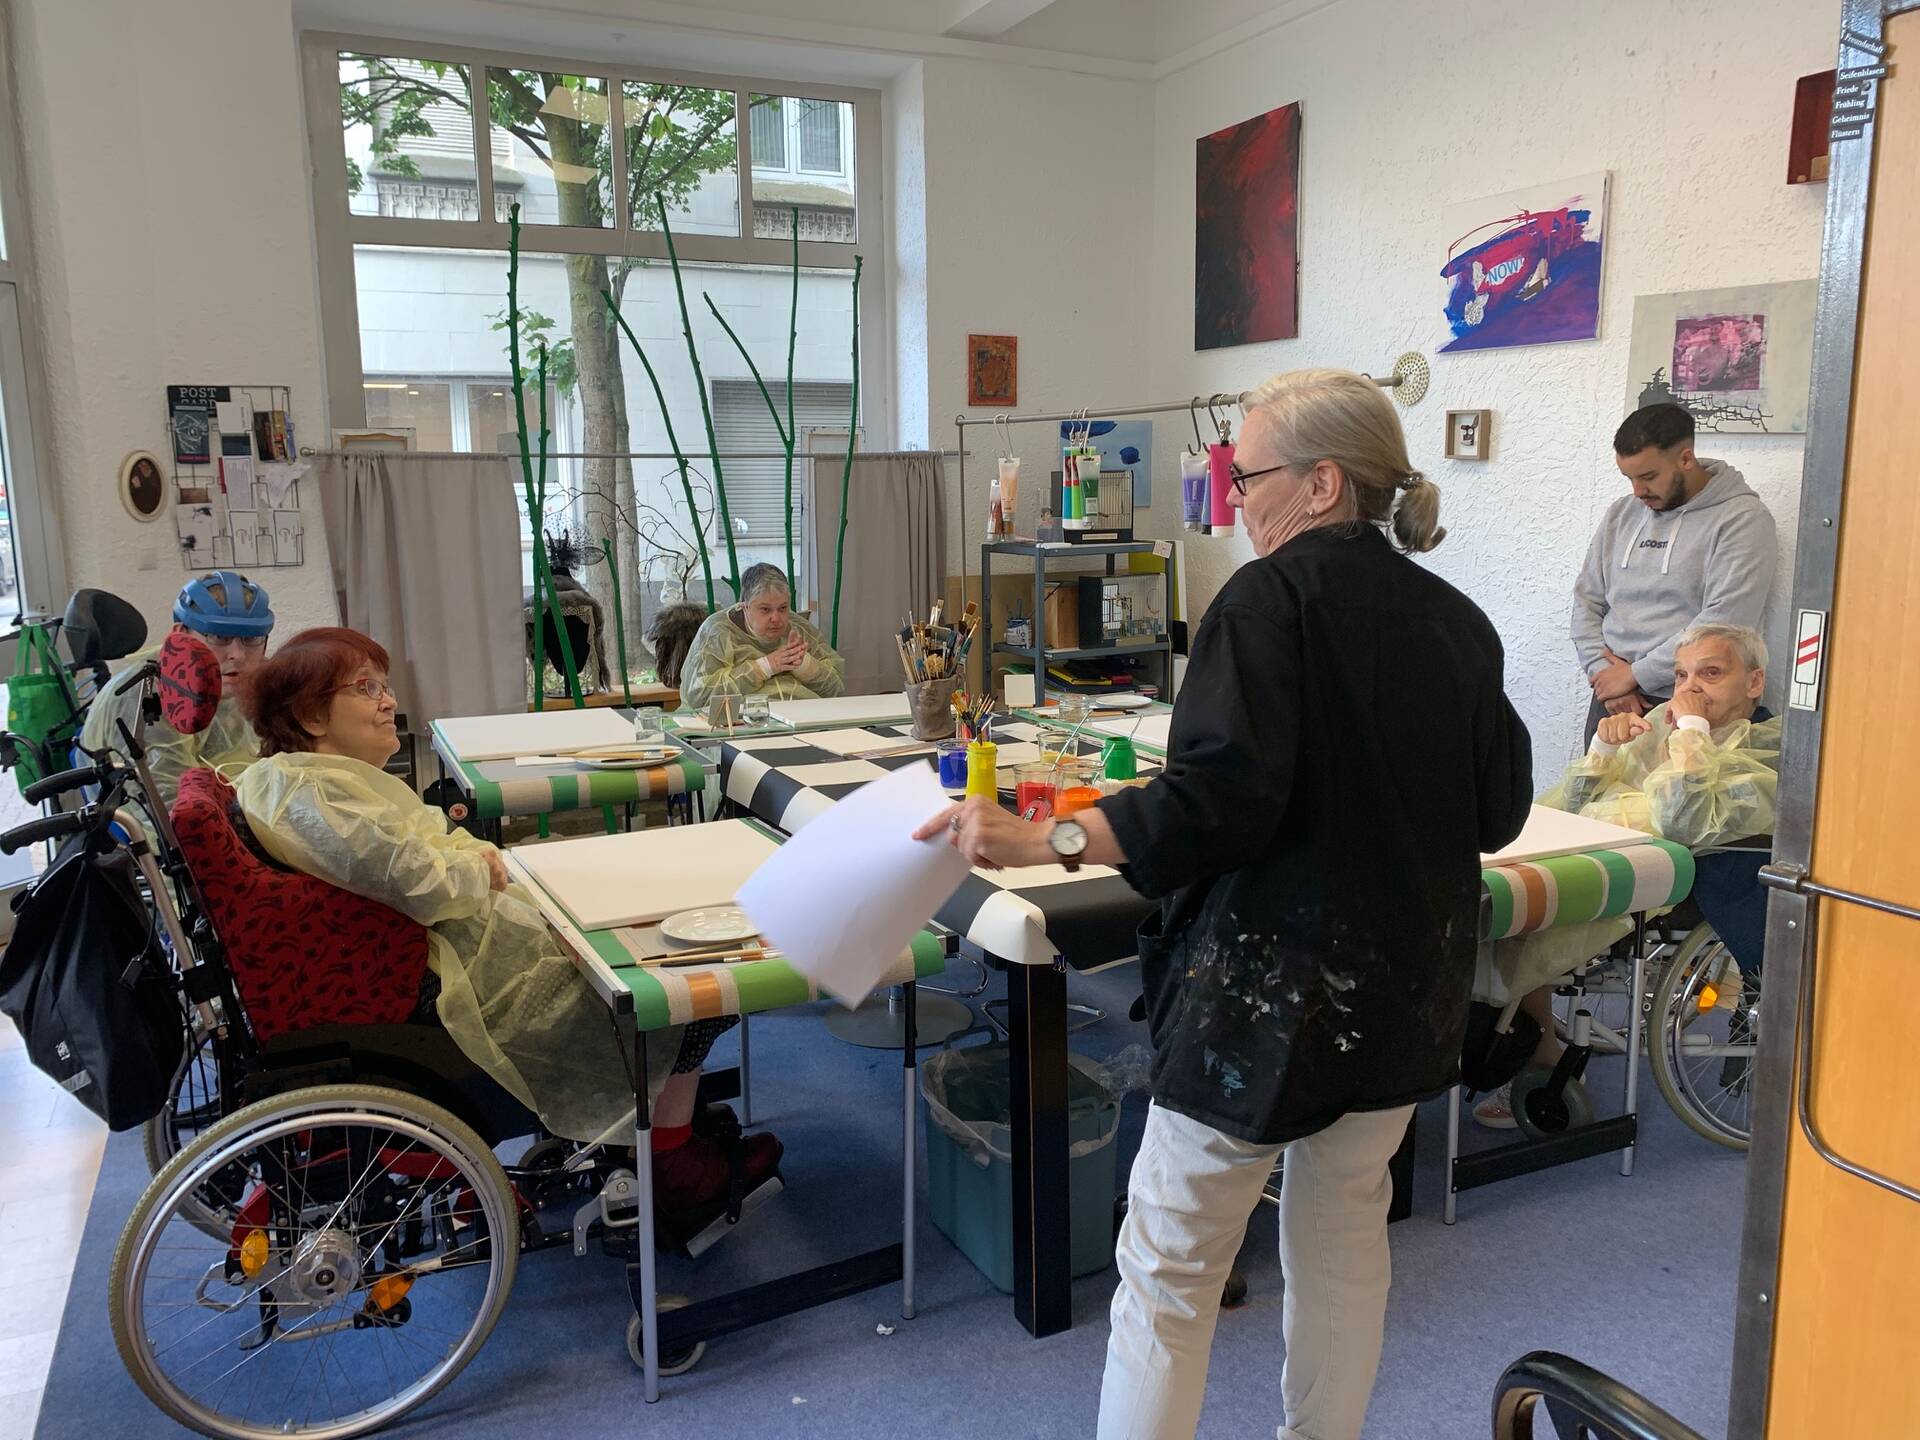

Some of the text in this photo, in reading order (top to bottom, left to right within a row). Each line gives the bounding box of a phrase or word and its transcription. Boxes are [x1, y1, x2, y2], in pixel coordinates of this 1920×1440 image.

[1844, 33, 1884, 53] Freundschaft
[1840, 68, 1885, 80] Seifenblasen
[1836, 85, 1859, 94] Friede
[1835, 100, 1865, 109] Frühling
[1832, 113, 1870, 124] Geheimnis
[1831, 130, 1860, 138] Flüstern
[180, 387, 217, 398] POST
